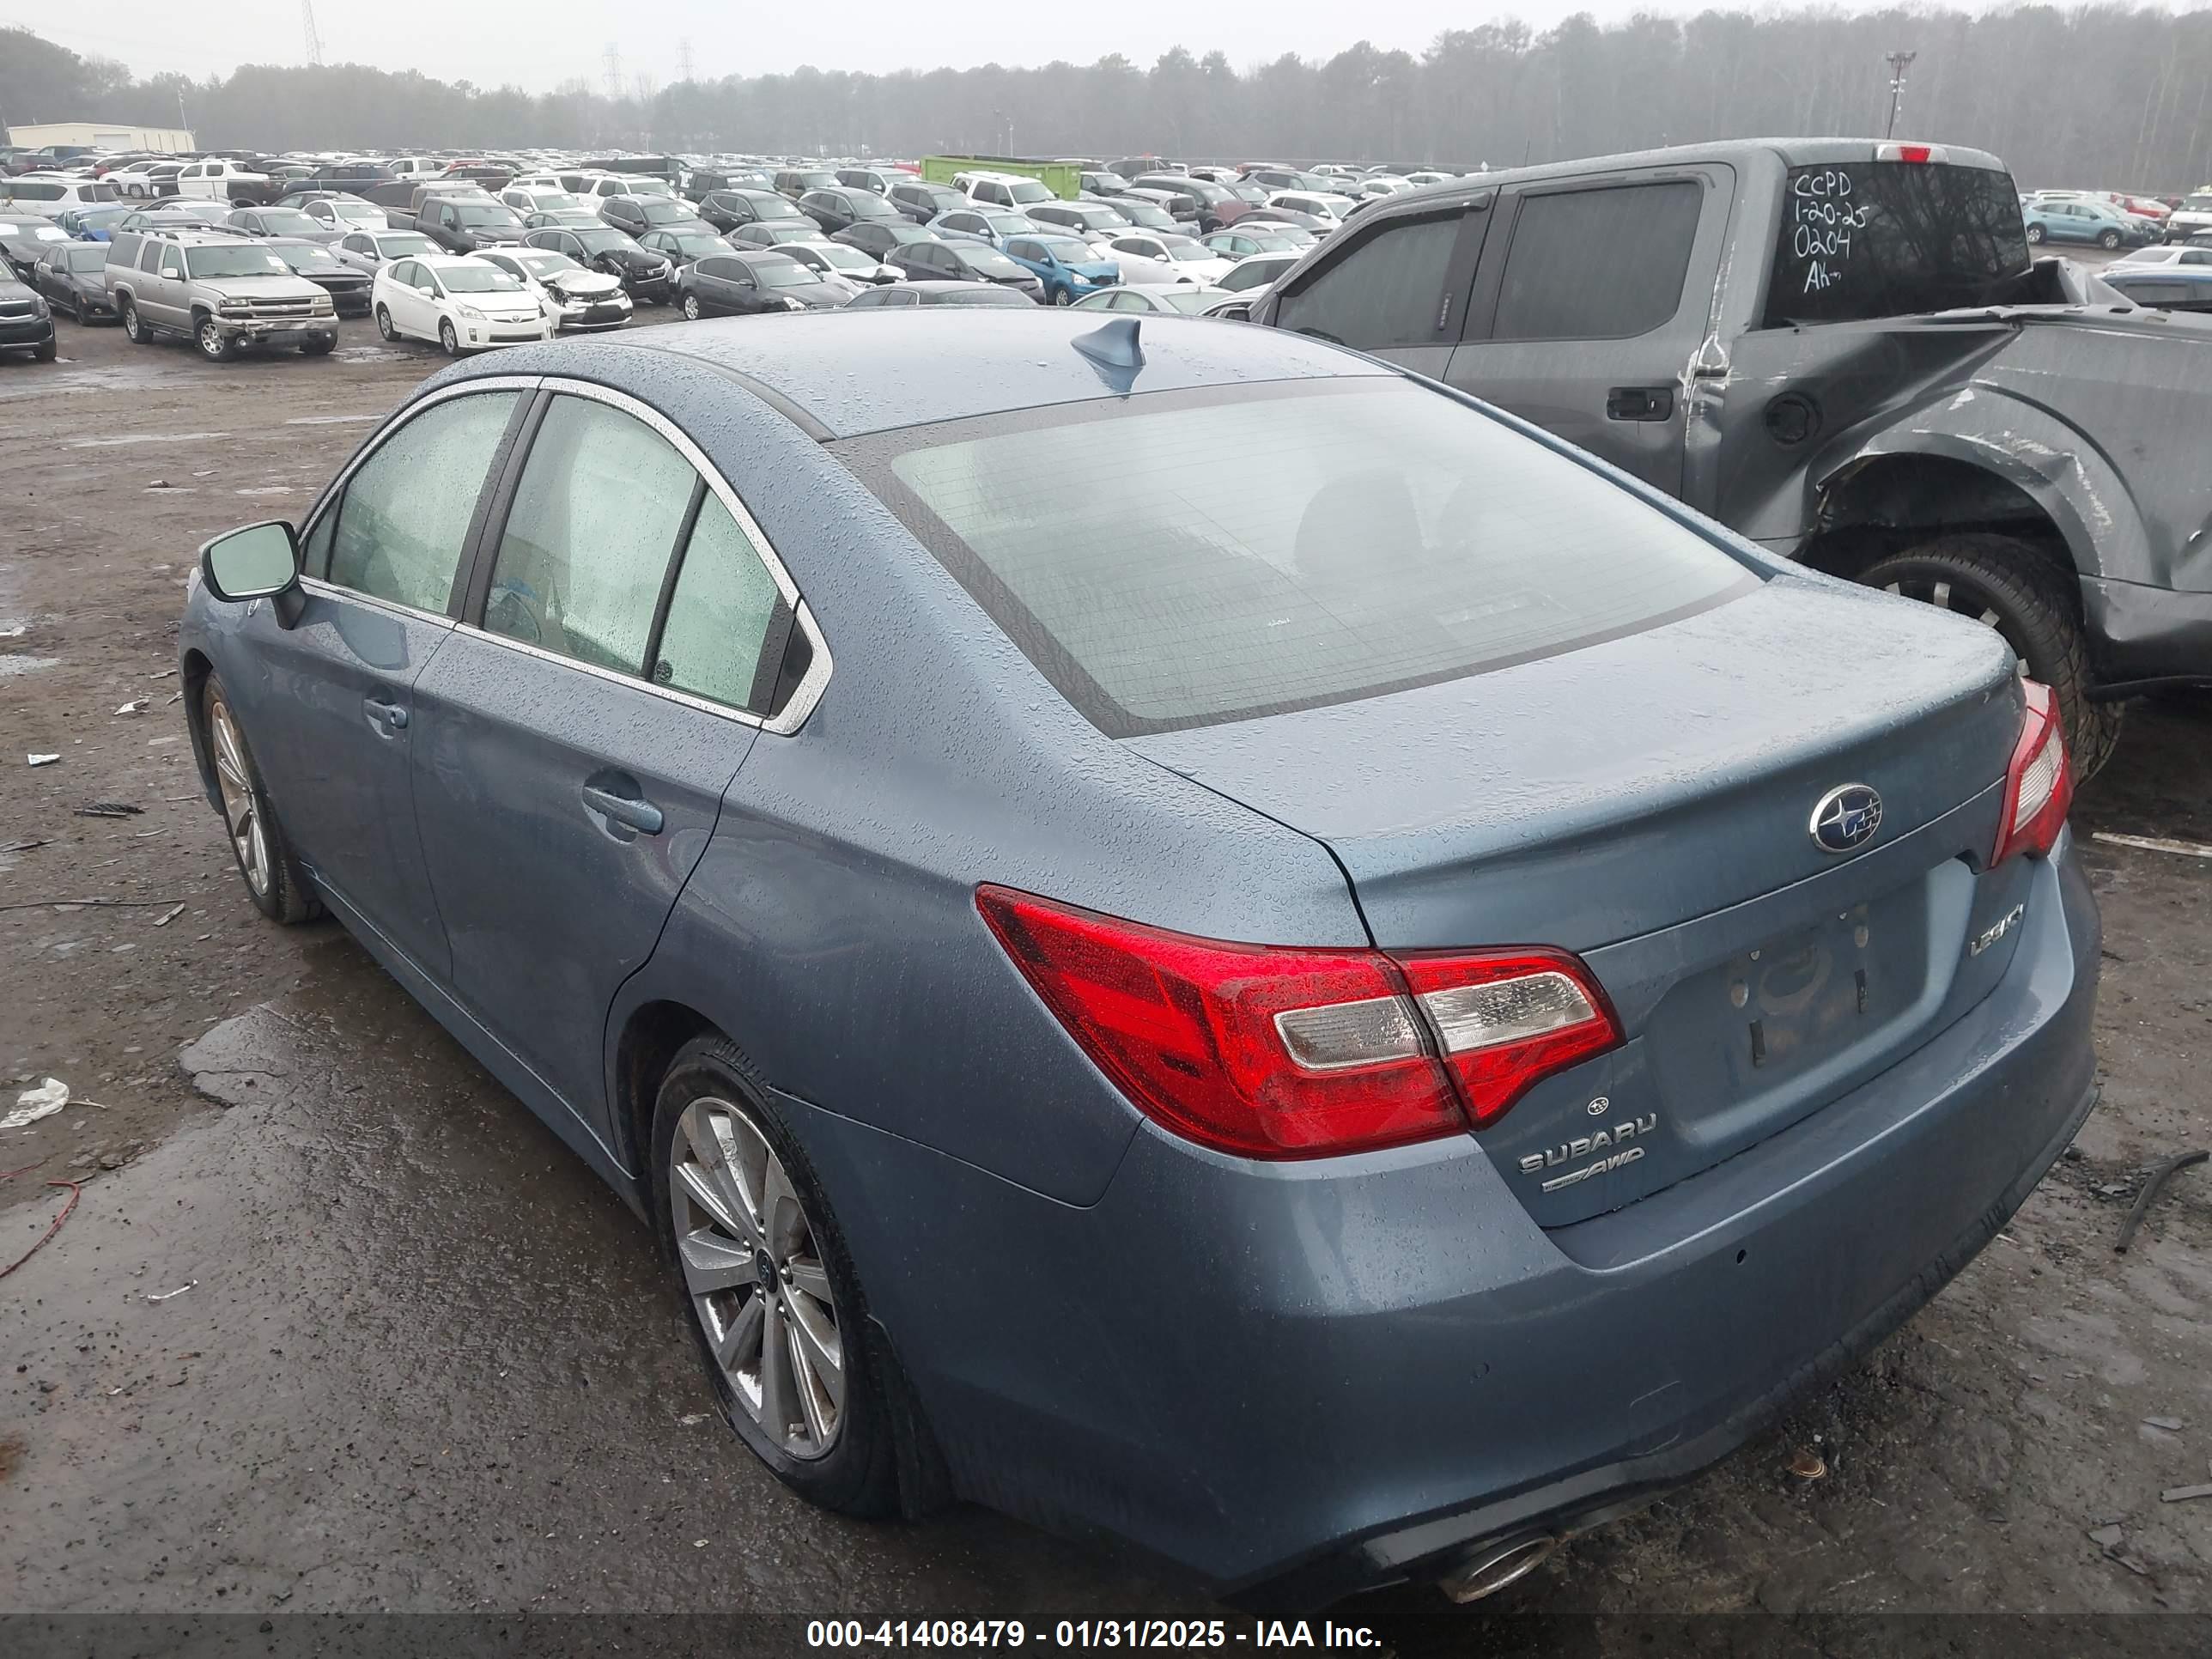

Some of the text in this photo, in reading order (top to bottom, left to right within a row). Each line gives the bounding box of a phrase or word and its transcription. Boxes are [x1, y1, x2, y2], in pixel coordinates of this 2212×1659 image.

[1794, 171, 1851, 198] CCPD
[1795, 198, 1869, 228] 1-20-25
[1794, 223, 1851, 260] 0204
[1518, 1112, 1657, 1175] SUBARU
[1582, 1146, 1646, 1180] AWD
